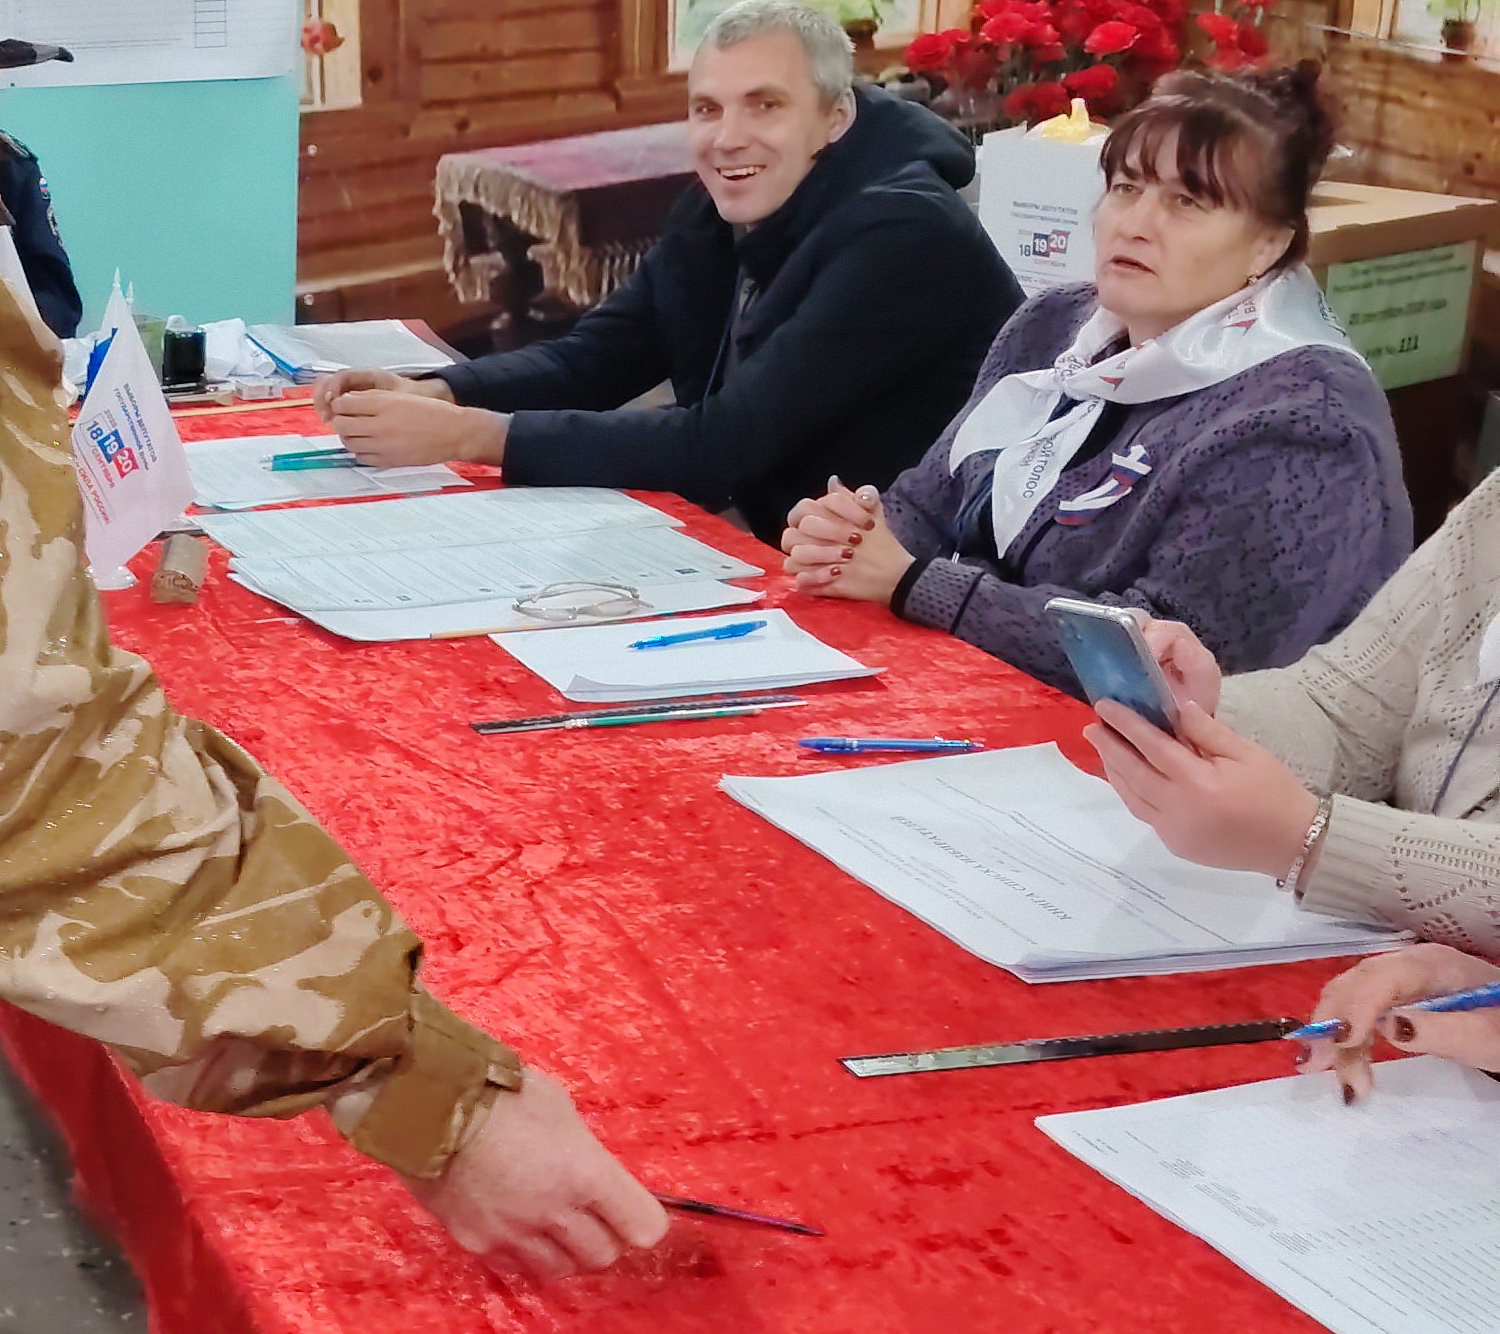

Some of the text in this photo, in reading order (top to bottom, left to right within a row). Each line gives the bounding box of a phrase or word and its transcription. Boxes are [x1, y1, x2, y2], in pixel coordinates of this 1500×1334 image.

[1019, 234, 1067, 257] 18 19 20
[86, 419, 134, 474] 18 19 20
[78, 467, 94, 490] СИЛА
[1022, 459, 1049, 499] ГОЛОС
[1024, 891, 1073, 921] КНИГА
